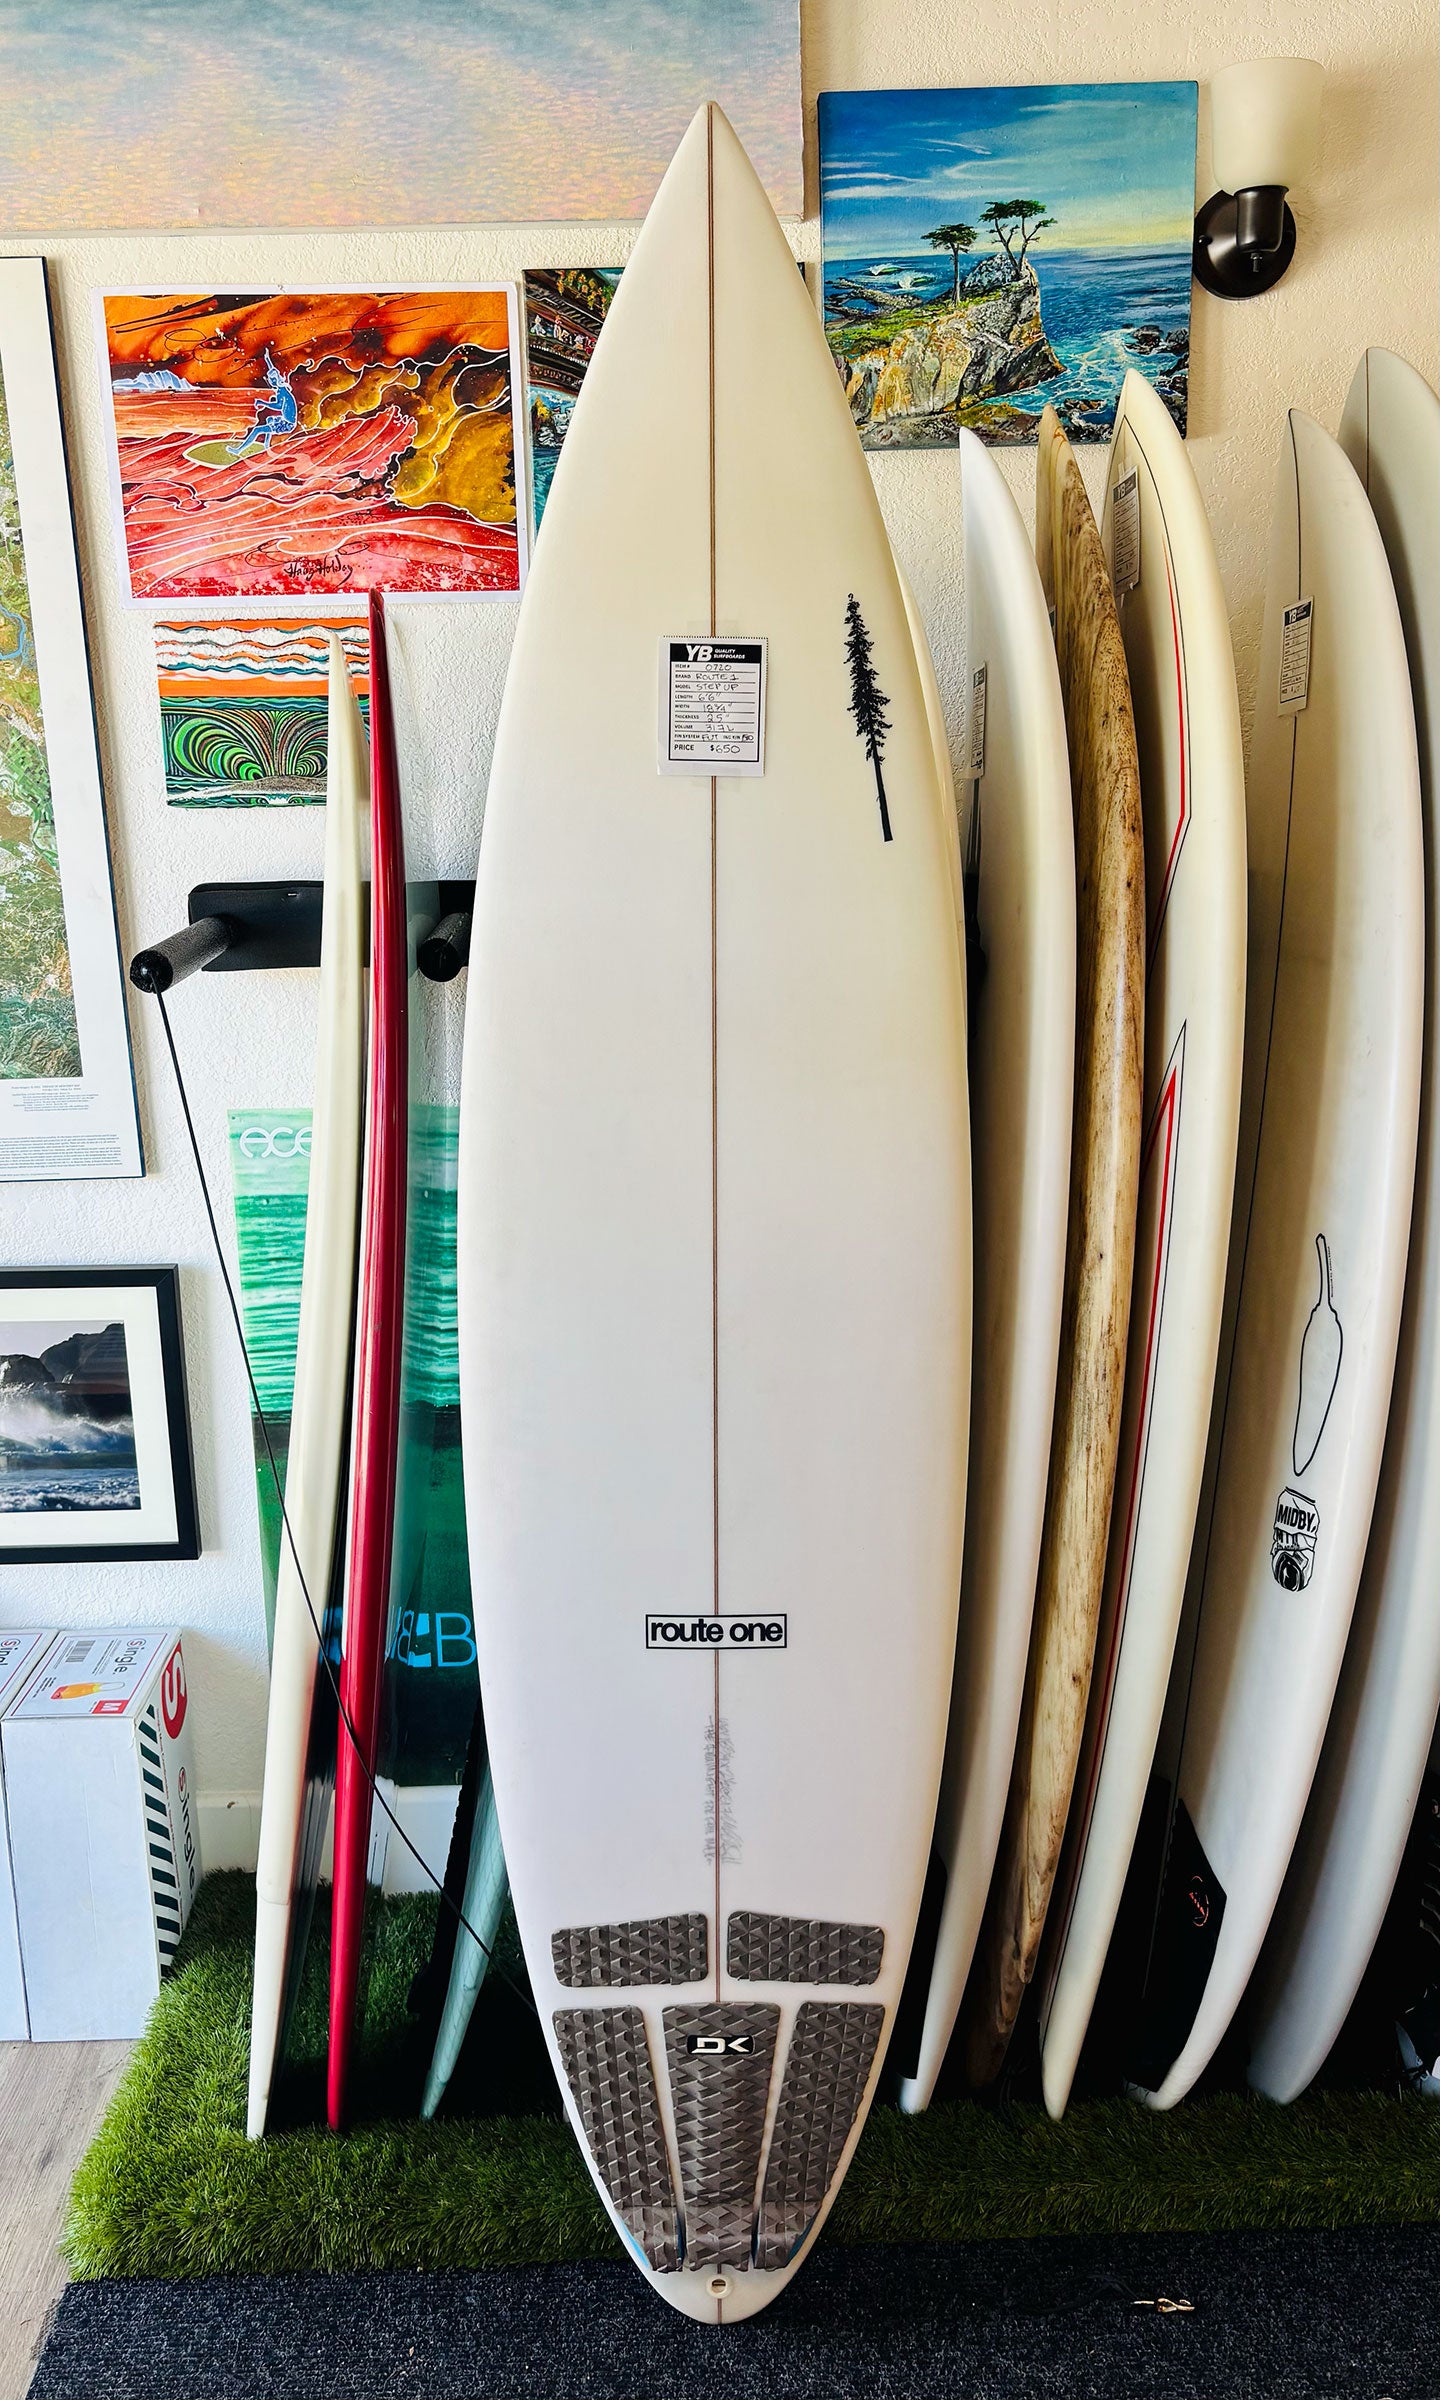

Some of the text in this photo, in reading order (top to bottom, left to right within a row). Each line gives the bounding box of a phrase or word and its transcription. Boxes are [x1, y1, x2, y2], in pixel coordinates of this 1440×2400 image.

[686, 645, 713, 662] YB
[710, 744, 741, 754] $650
[651, 1618, 783, 1643] route one
